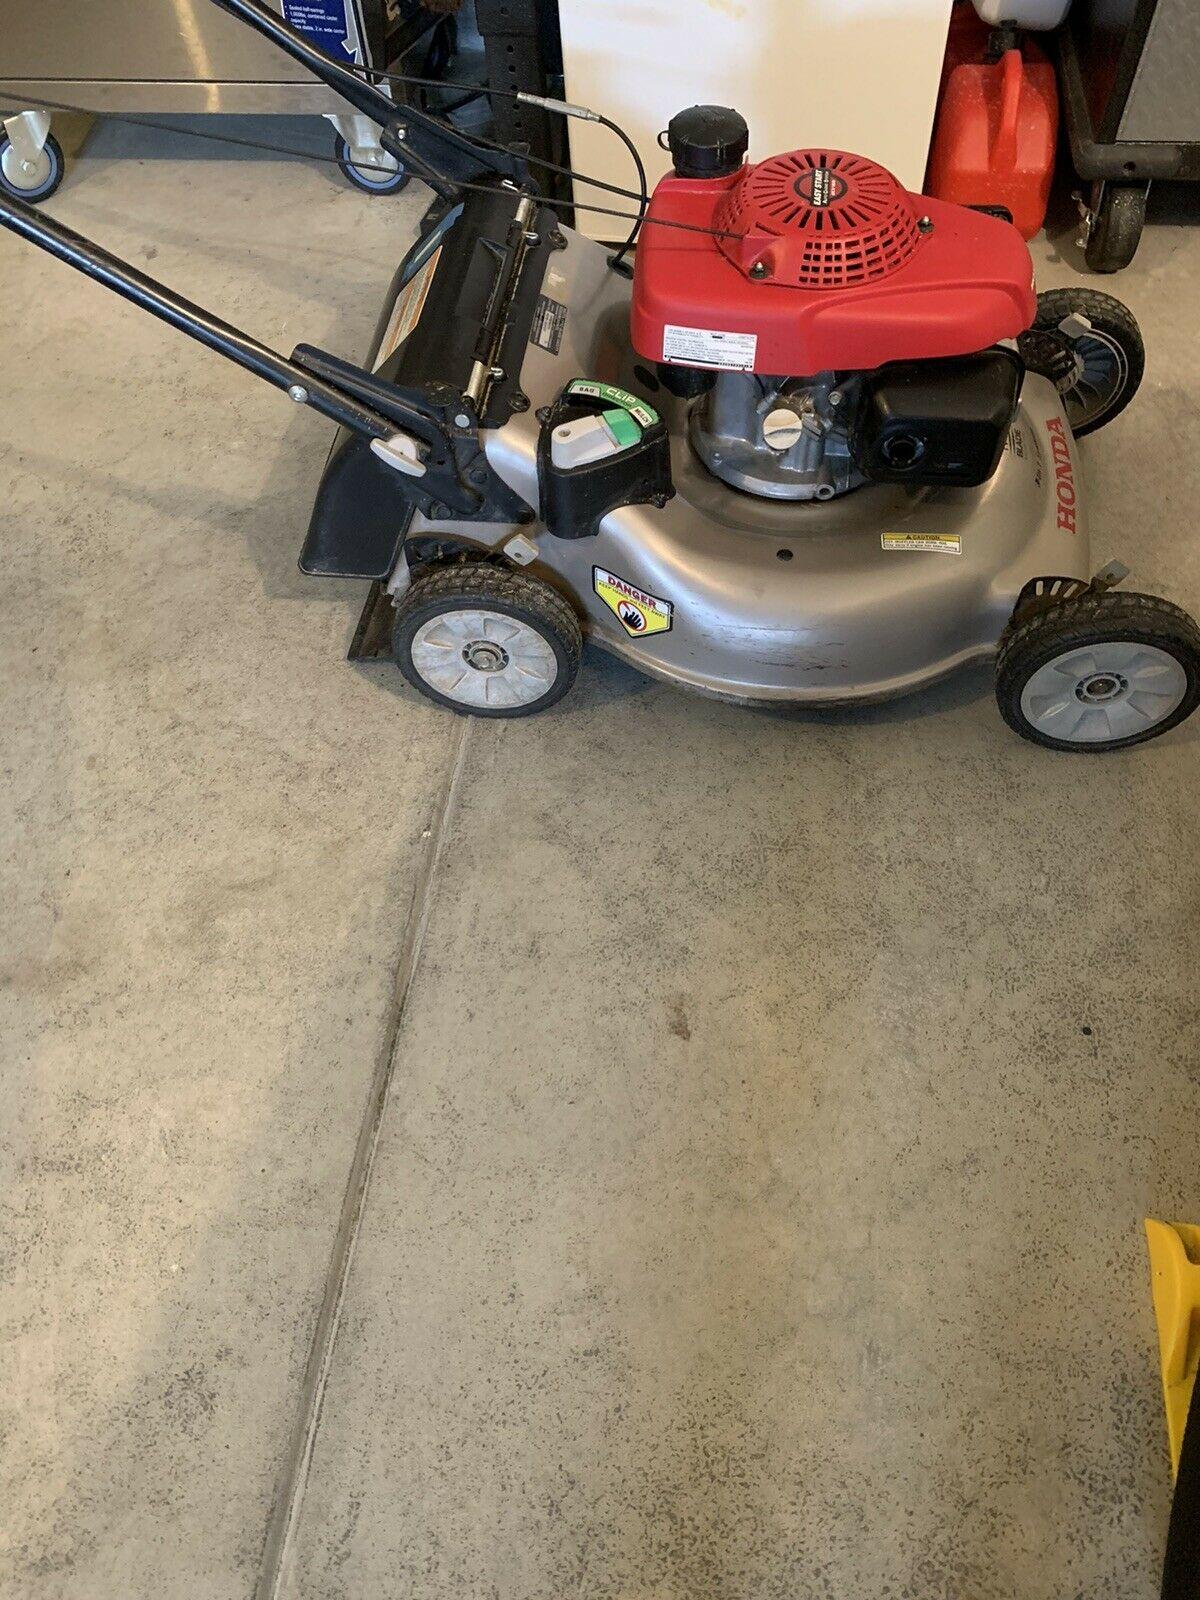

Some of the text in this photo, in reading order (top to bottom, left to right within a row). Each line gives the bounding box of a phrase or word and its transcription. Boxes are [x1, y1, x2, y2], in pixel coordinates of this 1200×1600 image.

[814, 170, 823, 206] EASY START
[1014, 429, 1024, 458] BLADE
[1046, 416, 1076, 534] HONDA
[607, 575, 656, 608] DANGER
